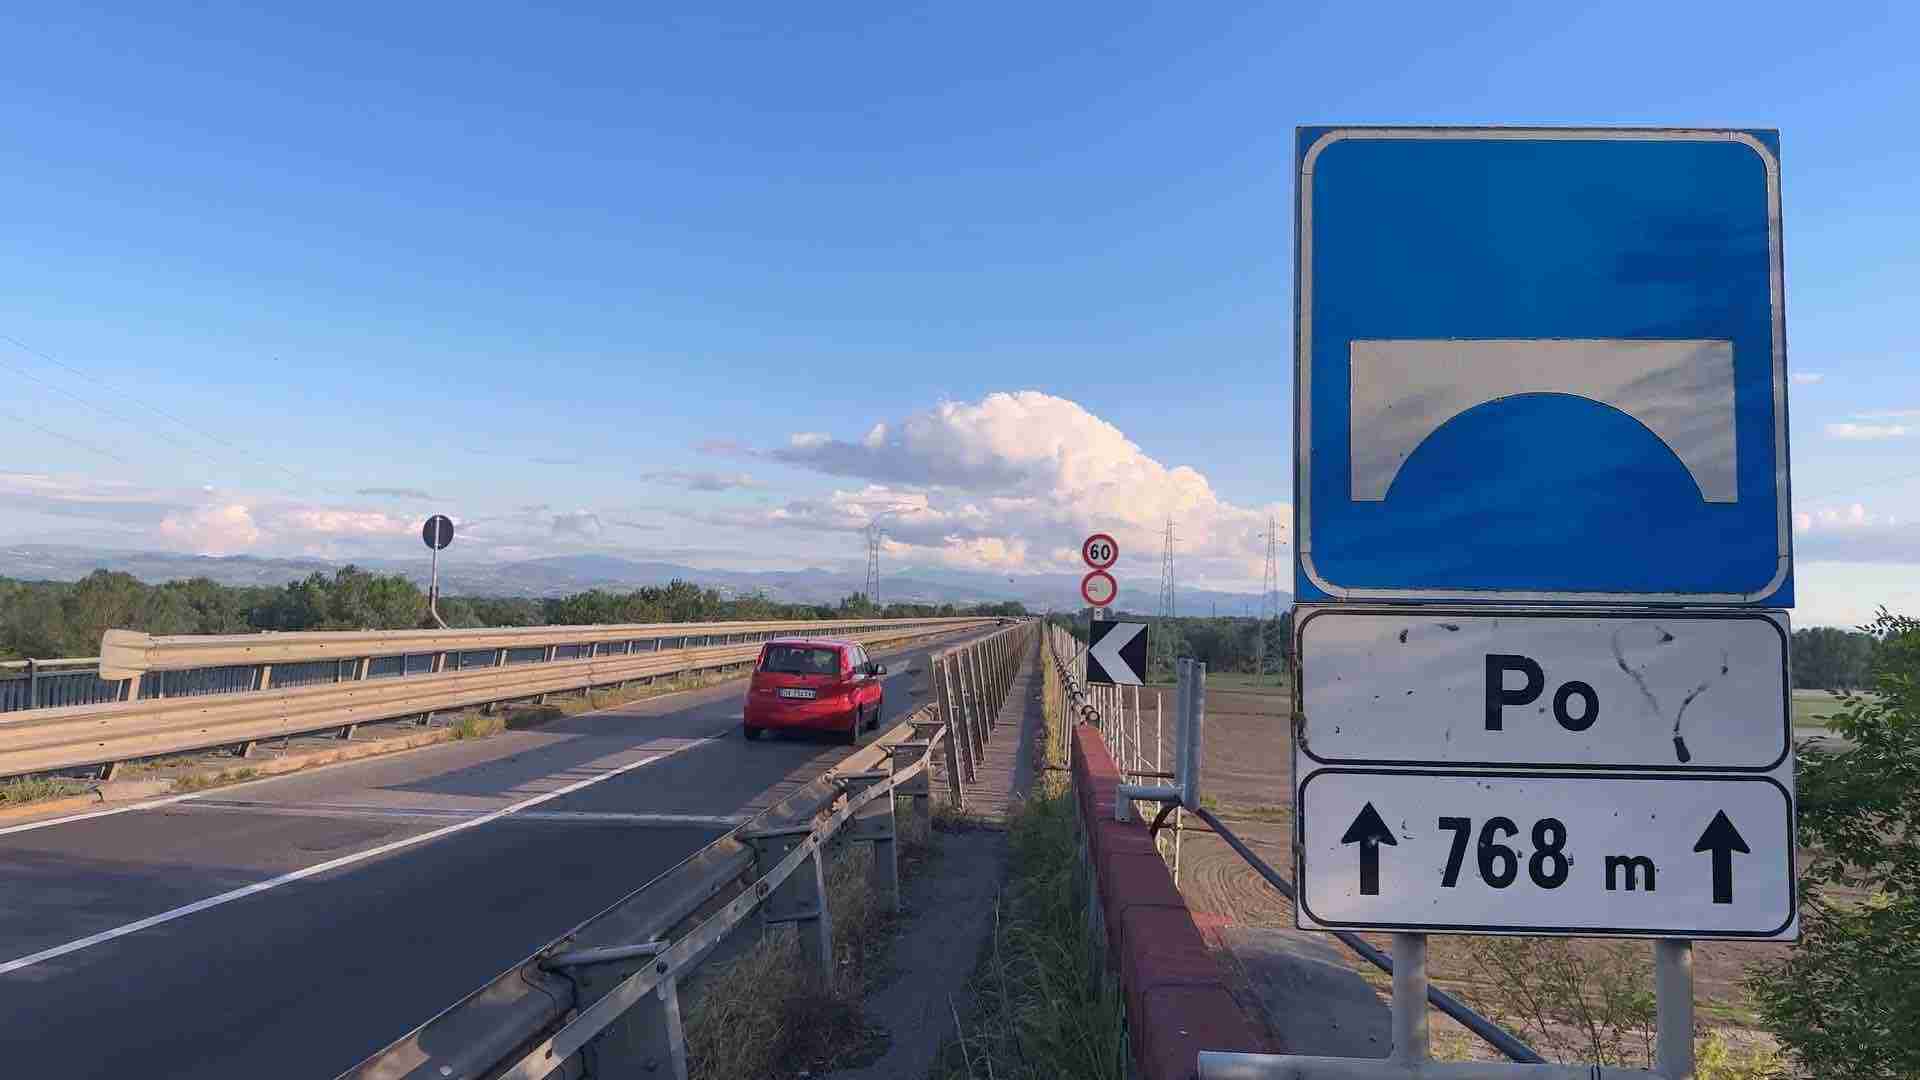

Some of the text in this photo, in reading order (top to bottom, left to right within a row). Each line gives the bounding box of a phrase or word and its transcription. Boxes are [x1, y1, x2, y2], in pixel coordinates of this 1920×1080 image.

[1090, 543, 1111, 560] 60
[1484, 653, 1600, 732] Po
[1437, 815, 1656, 892] 768 m
